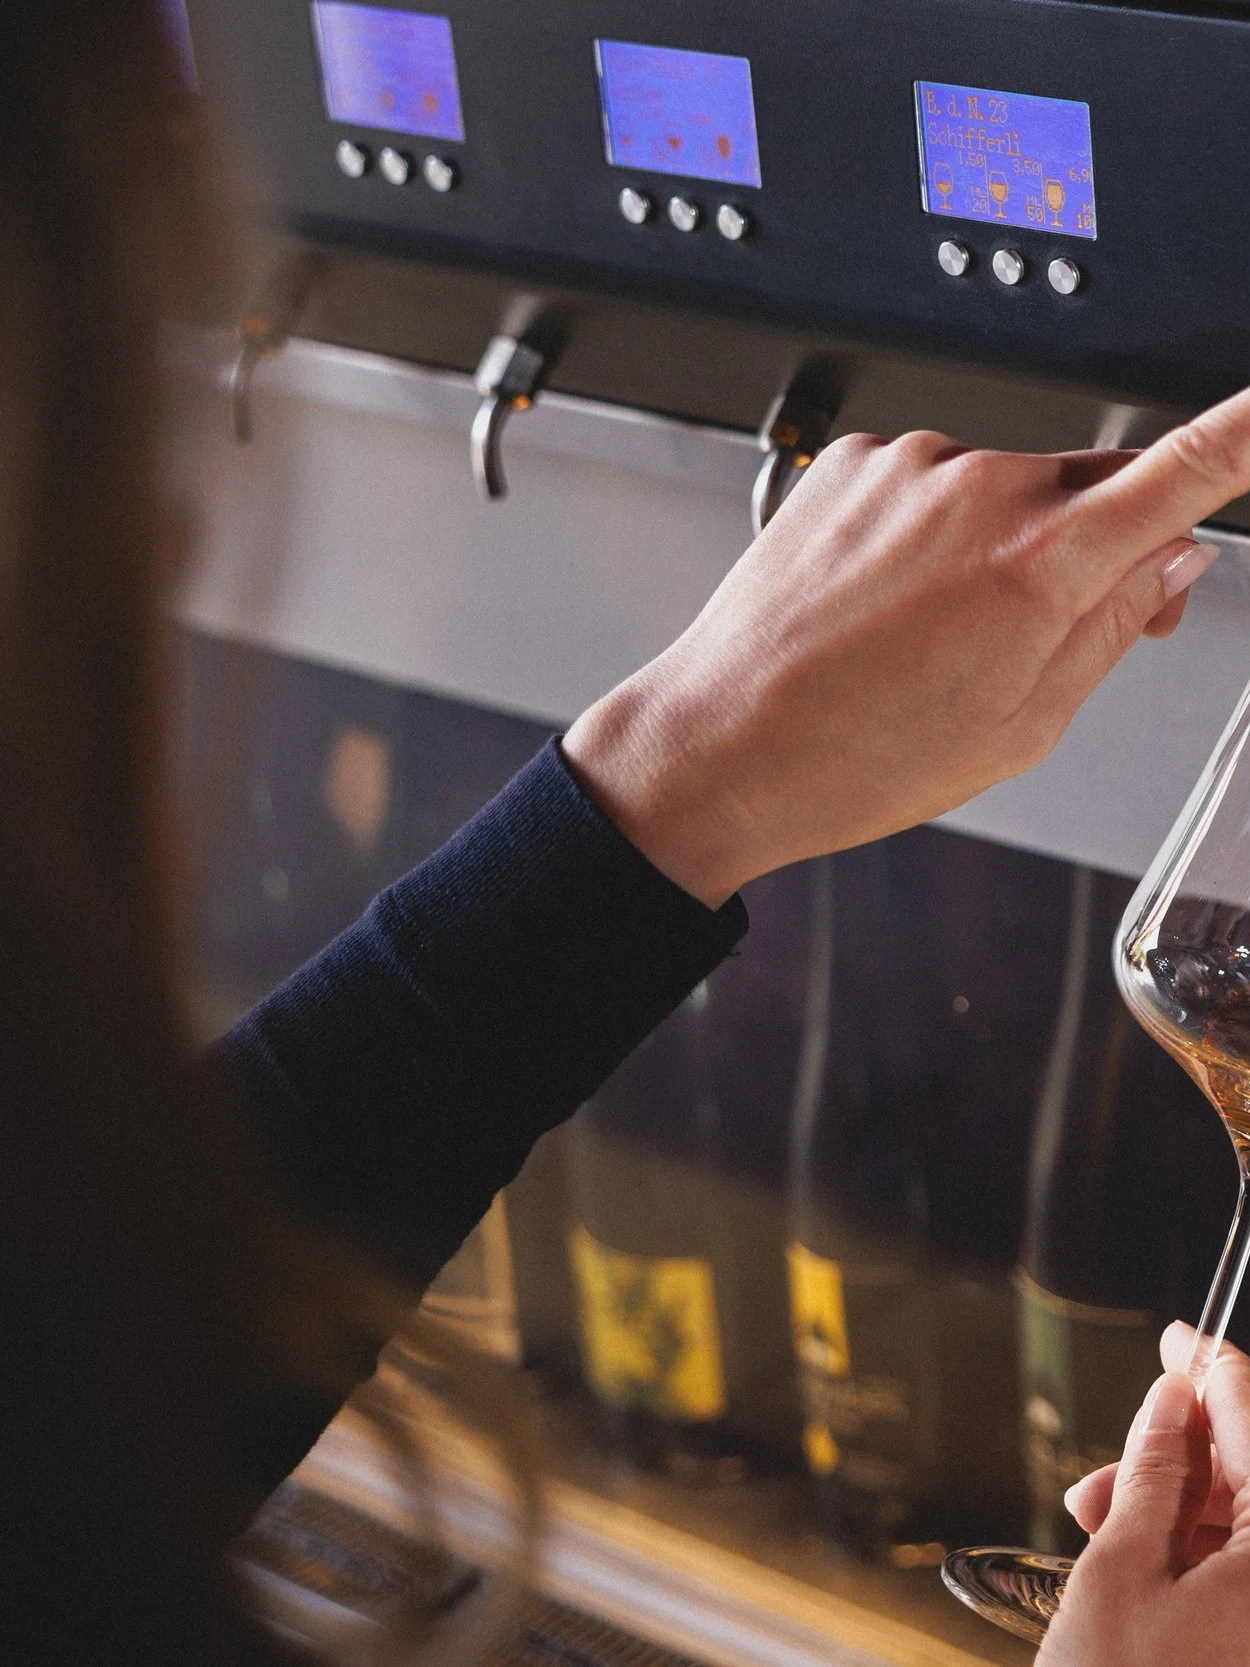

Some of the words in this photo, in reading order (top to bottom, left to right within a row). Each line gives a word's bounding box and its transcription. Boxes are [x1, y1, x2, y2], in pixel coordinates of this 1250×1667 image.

[925, 89, 942, 114] B.
[989, 97, 1008, 124] 23
[928, 121, 1022, 156] Schifferli
